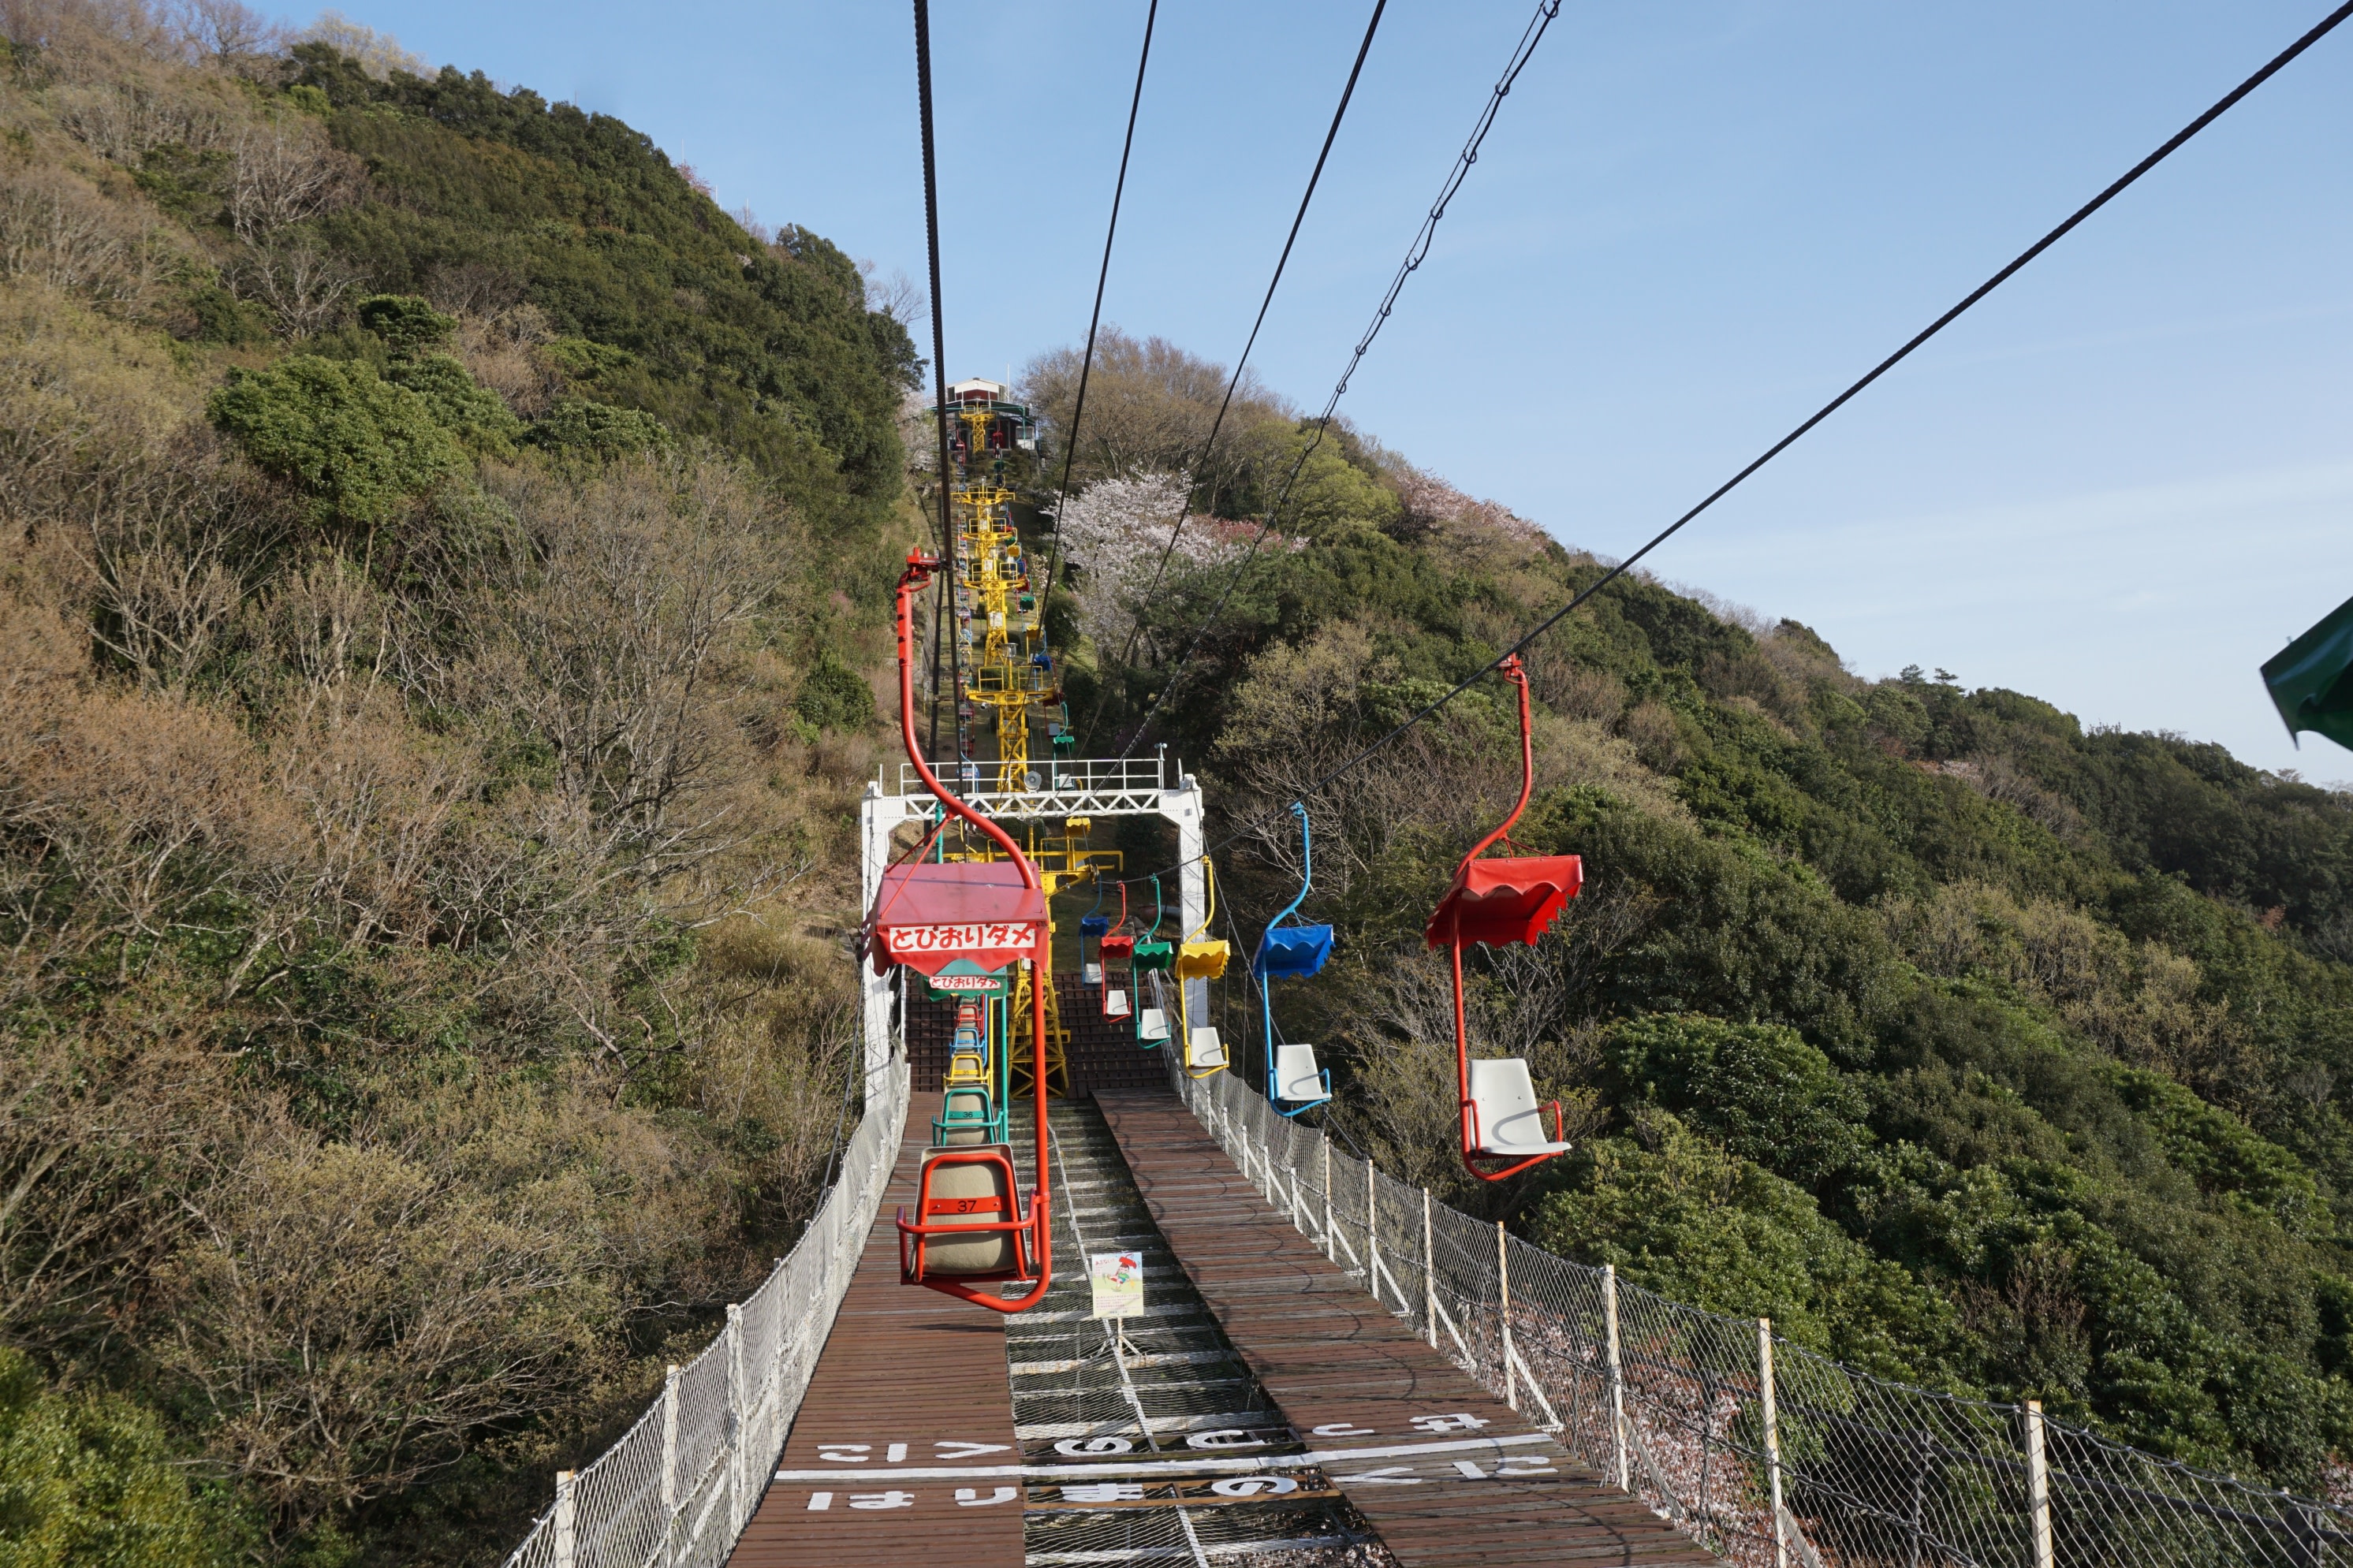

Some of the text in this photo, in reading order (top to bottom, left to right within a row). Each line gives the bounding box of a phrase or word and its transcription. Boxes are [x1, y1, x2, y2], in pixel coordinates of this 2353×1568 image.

[892, 923, 1035, 950] とびおりダメ
[931, 977, 998, 989] とびおりダメ
[957, 1200, 976, 1212] 37
